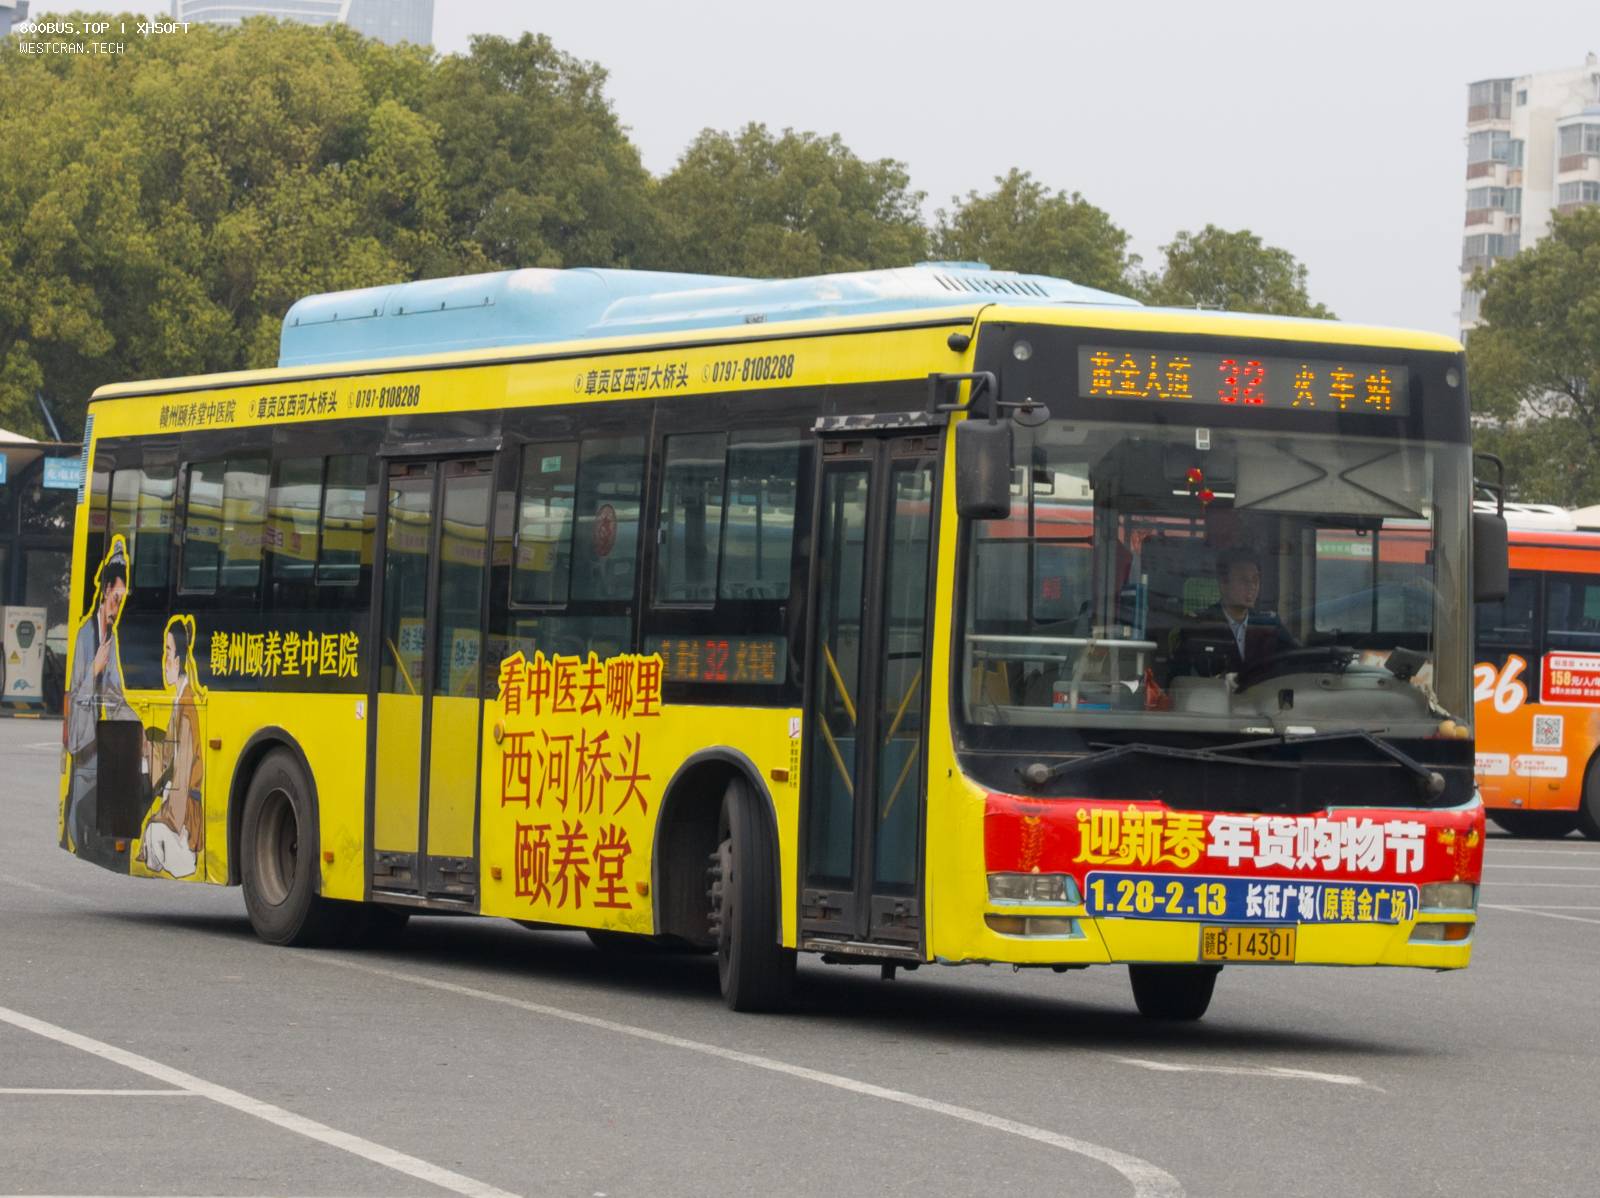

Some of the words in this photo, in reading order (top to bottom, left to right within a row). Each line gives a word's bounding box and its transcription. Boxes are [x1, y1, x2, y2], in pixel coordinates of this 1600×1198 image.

[584, 362, 689, 396] 章贡区西河大桥头
[712, 353, 795, 383] 0797-8108288
[1218, 358, 1265, 405] 32
[1291, 364, 1392, 410] 火车站
[159, 399, 236, 429] 赣州颐养堂中医院
[256, 390, 338, 419] 章贡区西河大桥头
[355, 384, 421, 409] 0797-8108288
[210, 630, 359, 678] 赣州颐养堂中医院
[500, 655, 662, 720] 看中医去哪里
[500, 727, 652, 817] 西河桥头
[514, 820, 633, 910] 颐养堂
[1090, 879, 1227, 916] 1.28-2.13
